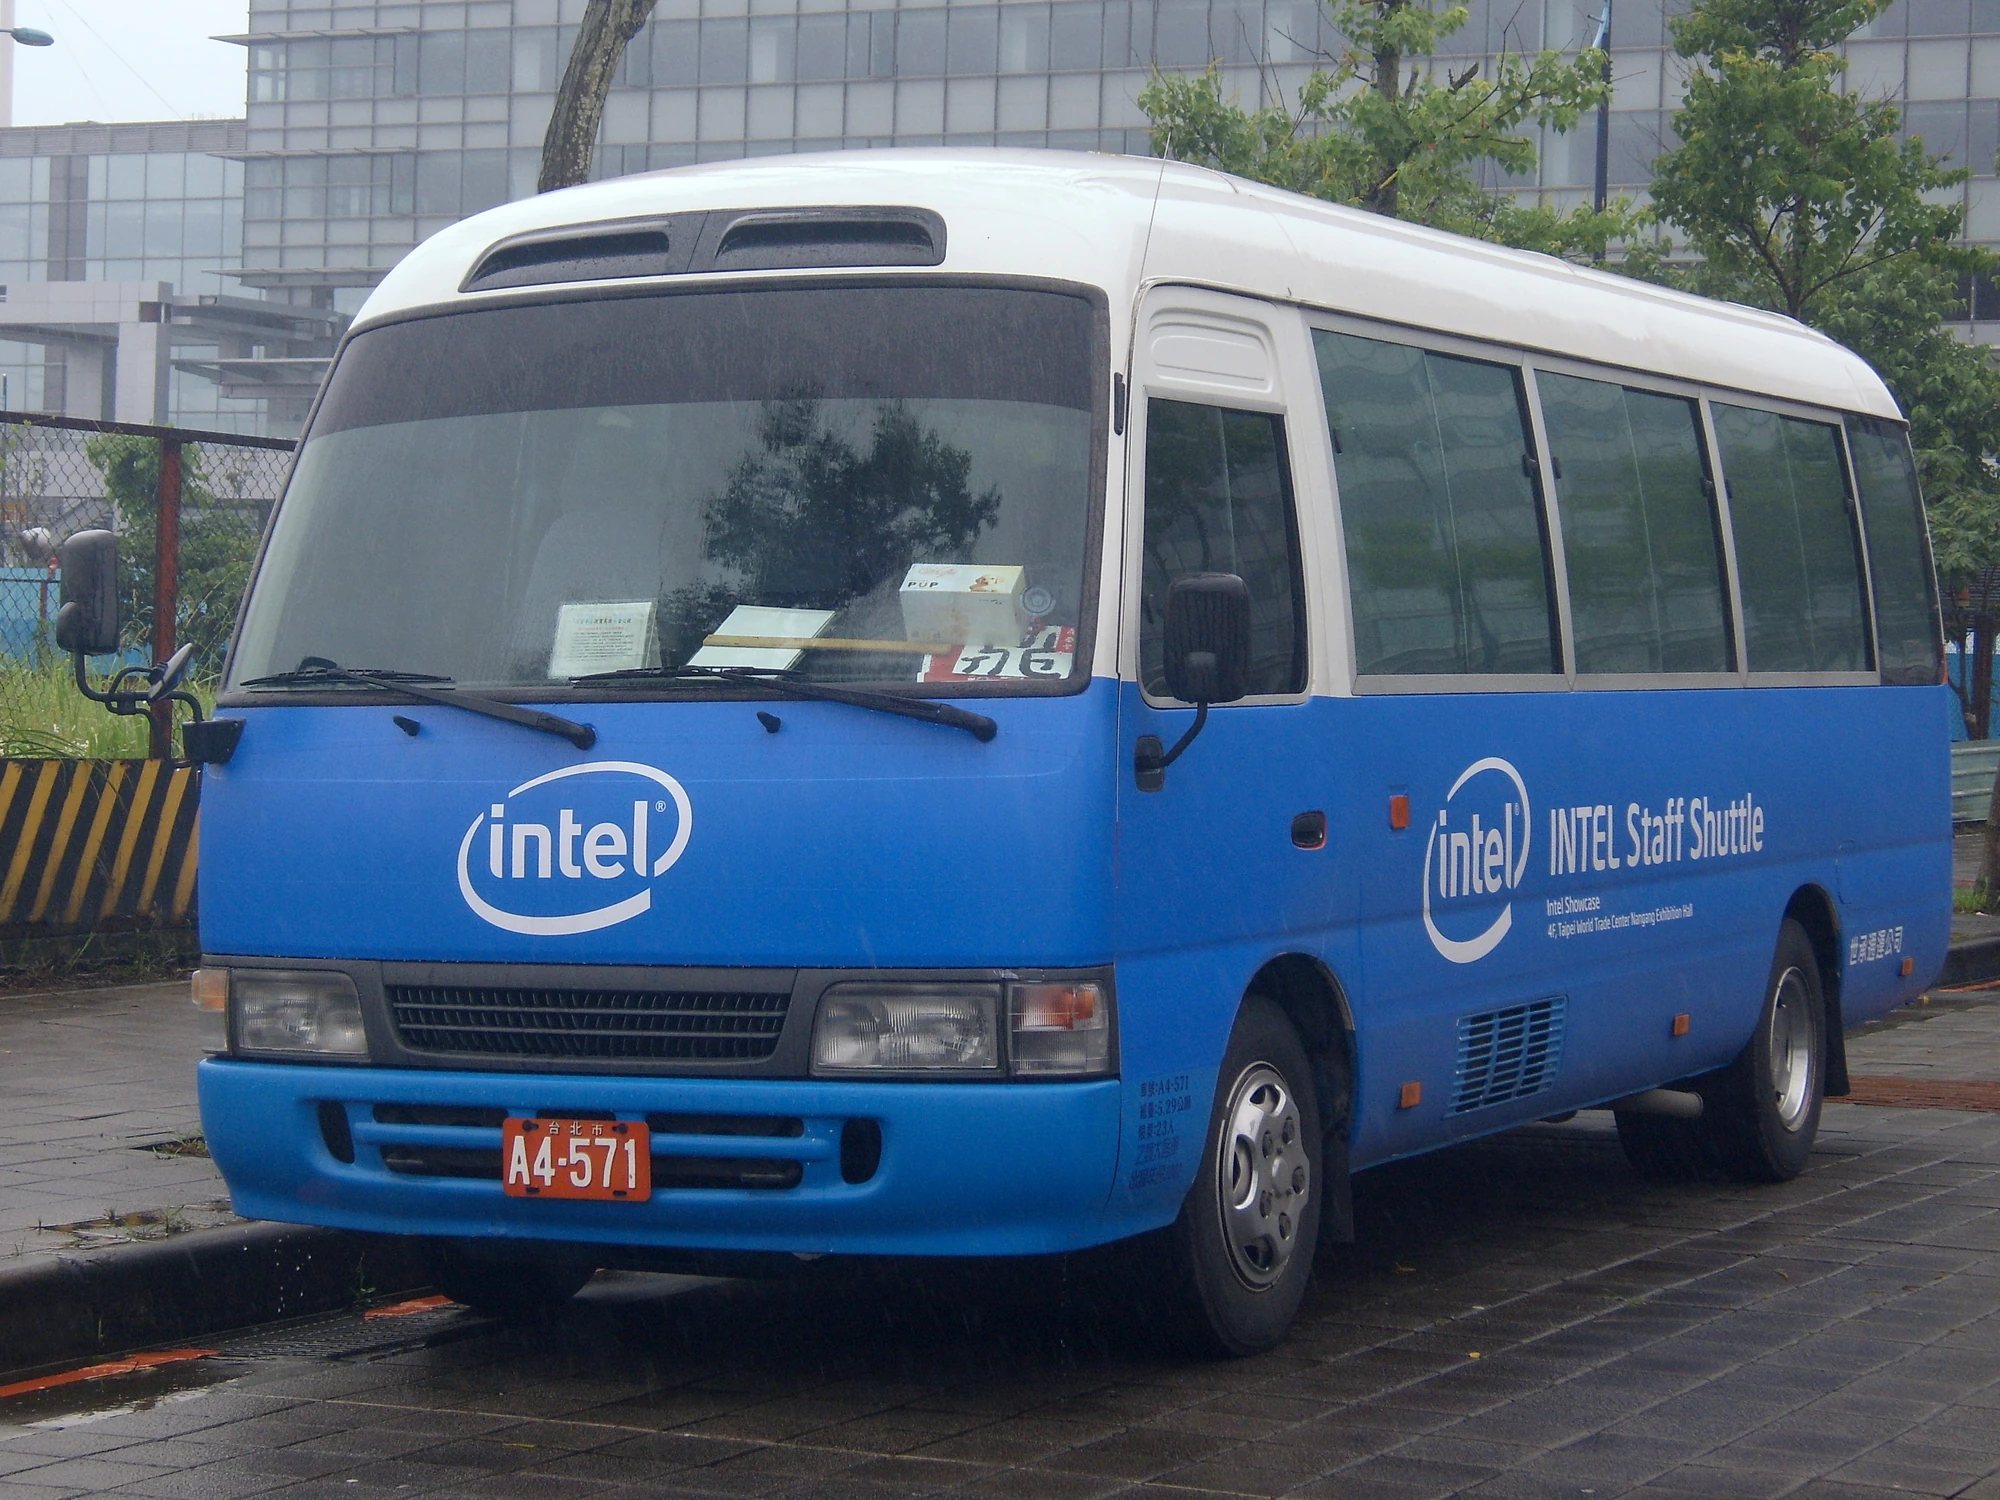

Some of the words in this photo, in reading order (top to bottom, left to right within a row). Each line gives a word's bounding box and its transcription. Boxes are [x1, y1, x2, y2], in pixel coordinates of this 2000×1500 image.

[489, 800, 648, 879] intel
[1440, 802, 1513, 898] intel
[1550, 804, 1620, 876] INTEL
[1626, 797, 1685, 868] Staff
[1690, 792, 1765, 860] Shuttle
[1547, 898, 1564, 916] Intel
[1565, 896, 1600, 915] Showcase
[1558, 920, 1577, 939] Taipei
[1576, 917, 1594, 934] World
[1594, 915, 1612, 932] Trade
[1611, 914, 1631, 929] Center
[1630, 909, 1656, 928] Nangang
[1655, 905, 1683, 922] Exhibition
[1682, 903, 1694, 918] Hall
[549, 1121, 603, 1136] 台北市
[508, 1135, 636, 1189] A4-571
